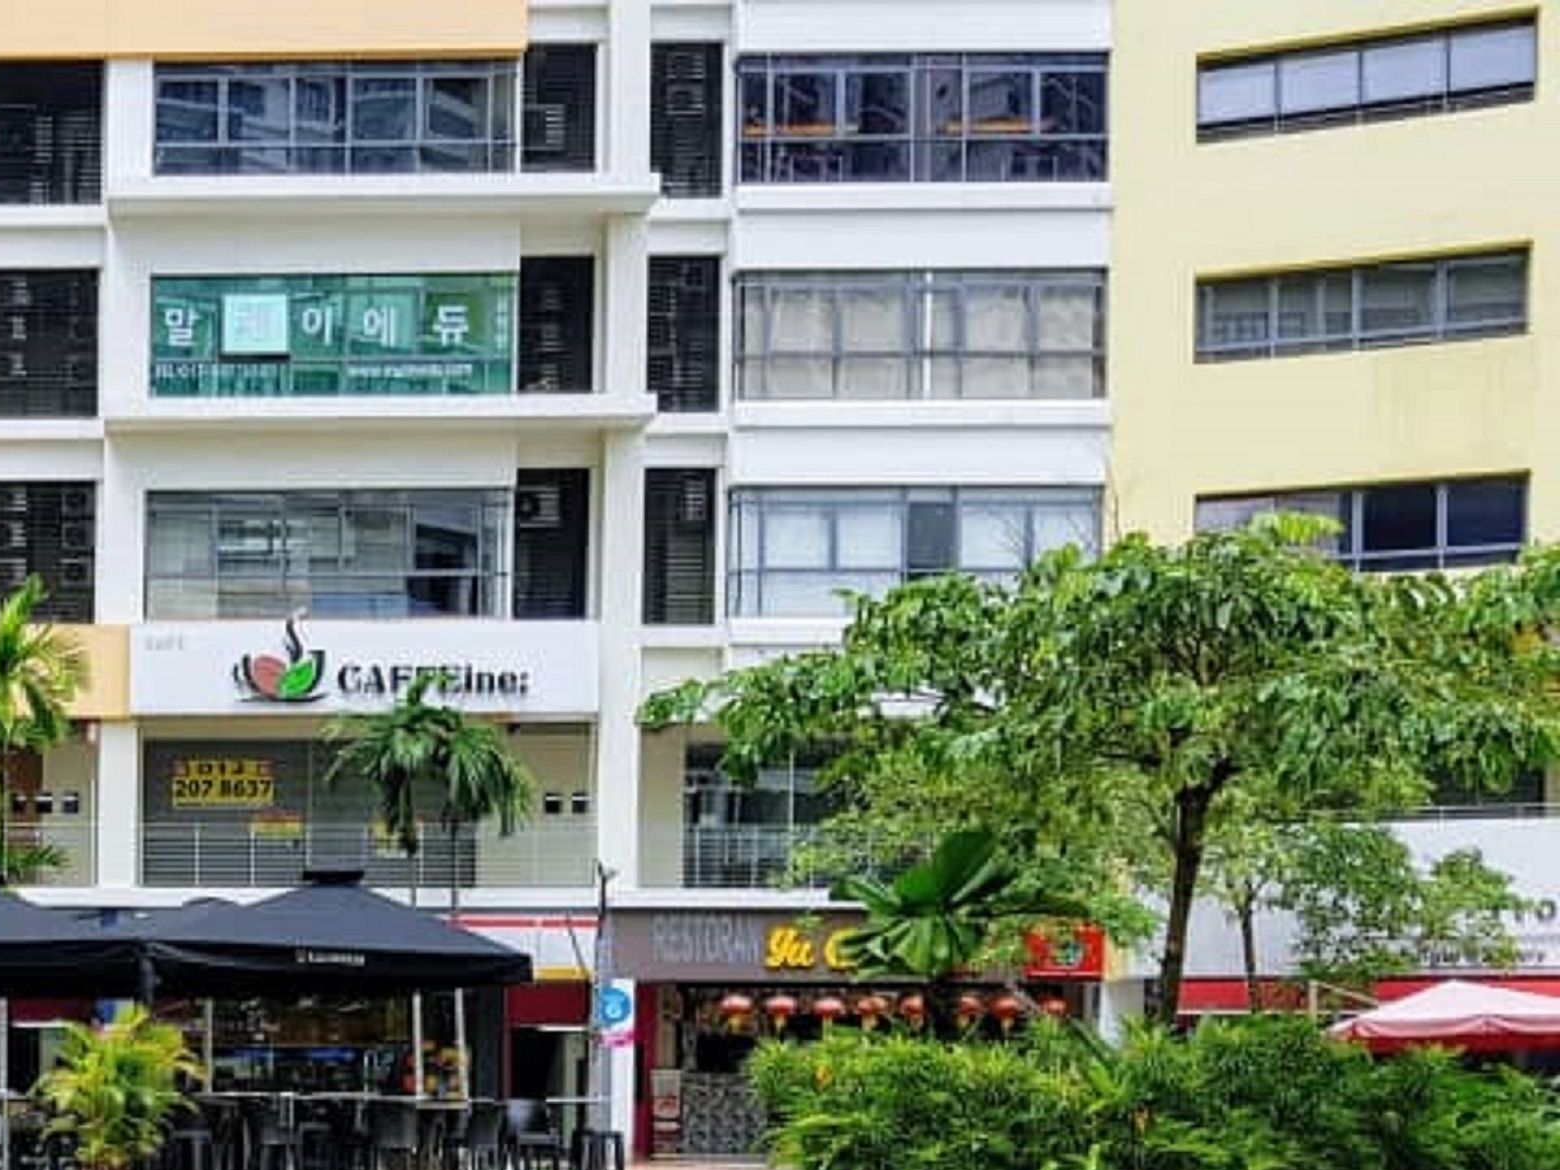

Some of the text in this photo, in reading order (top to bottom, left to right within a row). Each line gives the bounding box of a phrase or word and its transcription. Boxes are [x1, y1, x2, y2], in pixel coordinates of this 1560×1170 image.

[164, 305, 470, 348] 말이에듀
[175, 779, 213, 798] 207
[652, 914, 759, 963] RESTORAN
